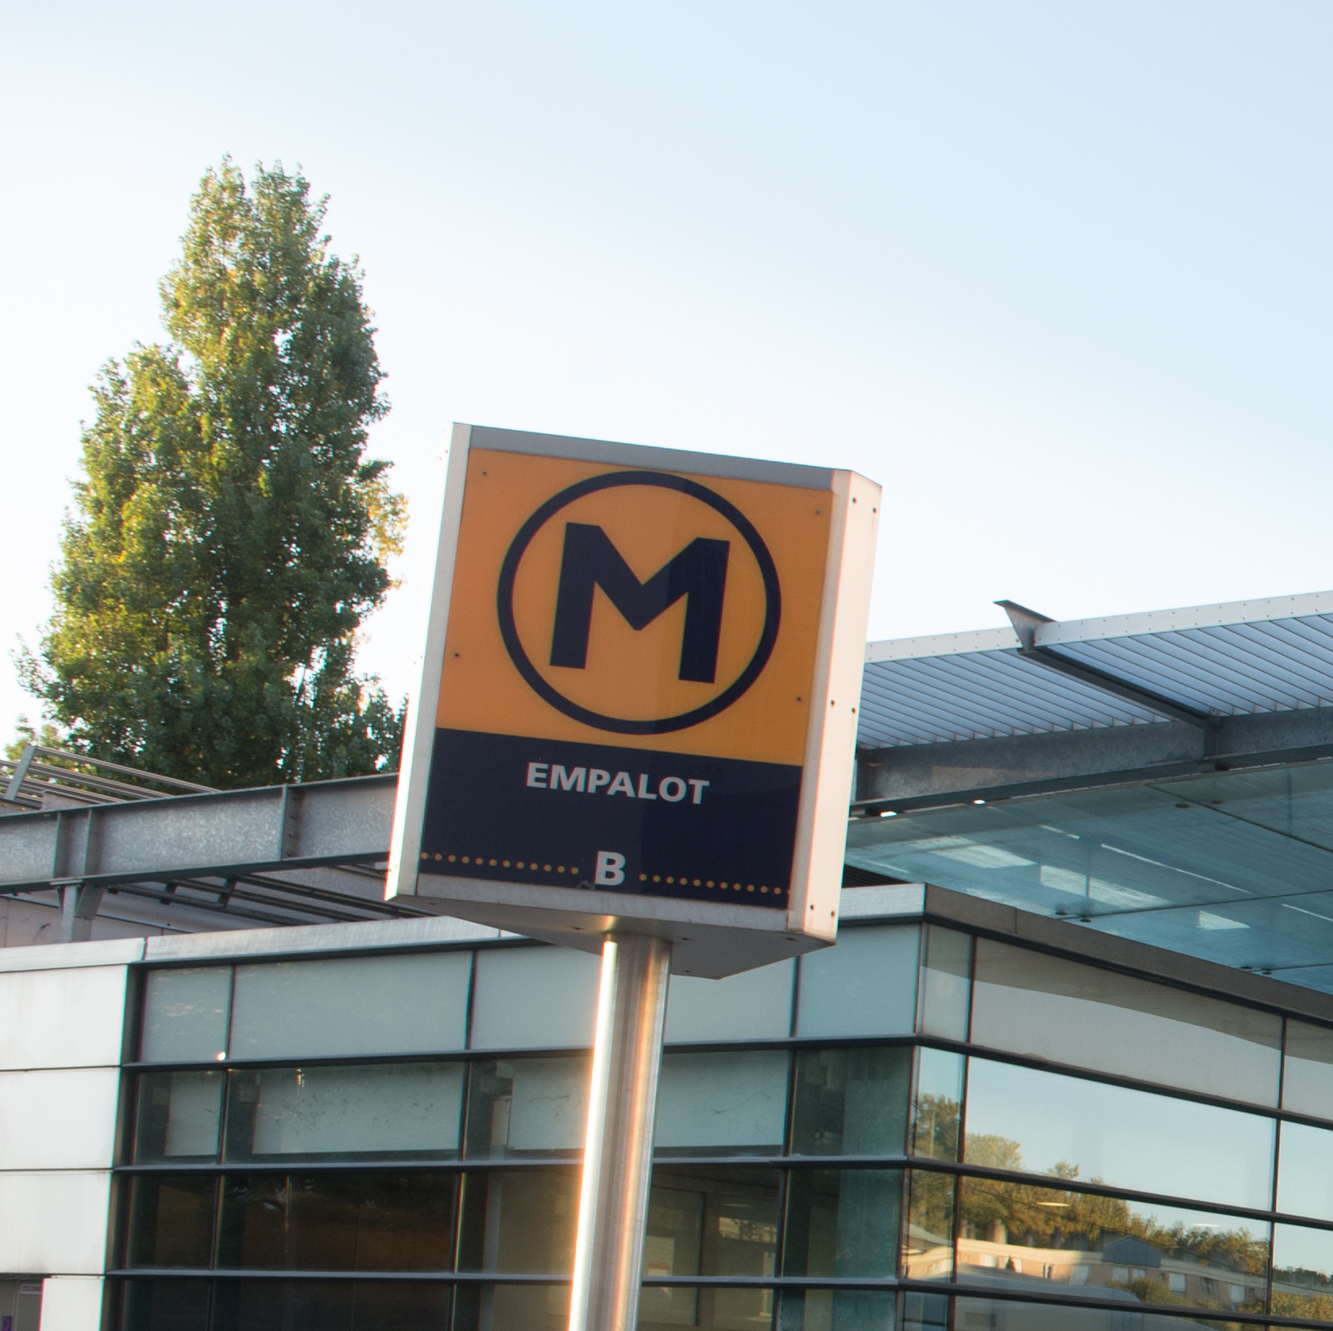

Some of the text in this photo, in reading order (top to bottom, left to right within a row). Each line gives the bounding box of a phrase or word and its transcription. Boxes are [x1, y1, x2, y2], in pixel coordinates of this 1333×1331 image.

[550, 522, 730, 684] M
[525, 761, 710, 805] EMPALOT
[595, 851, 625, 886] B
